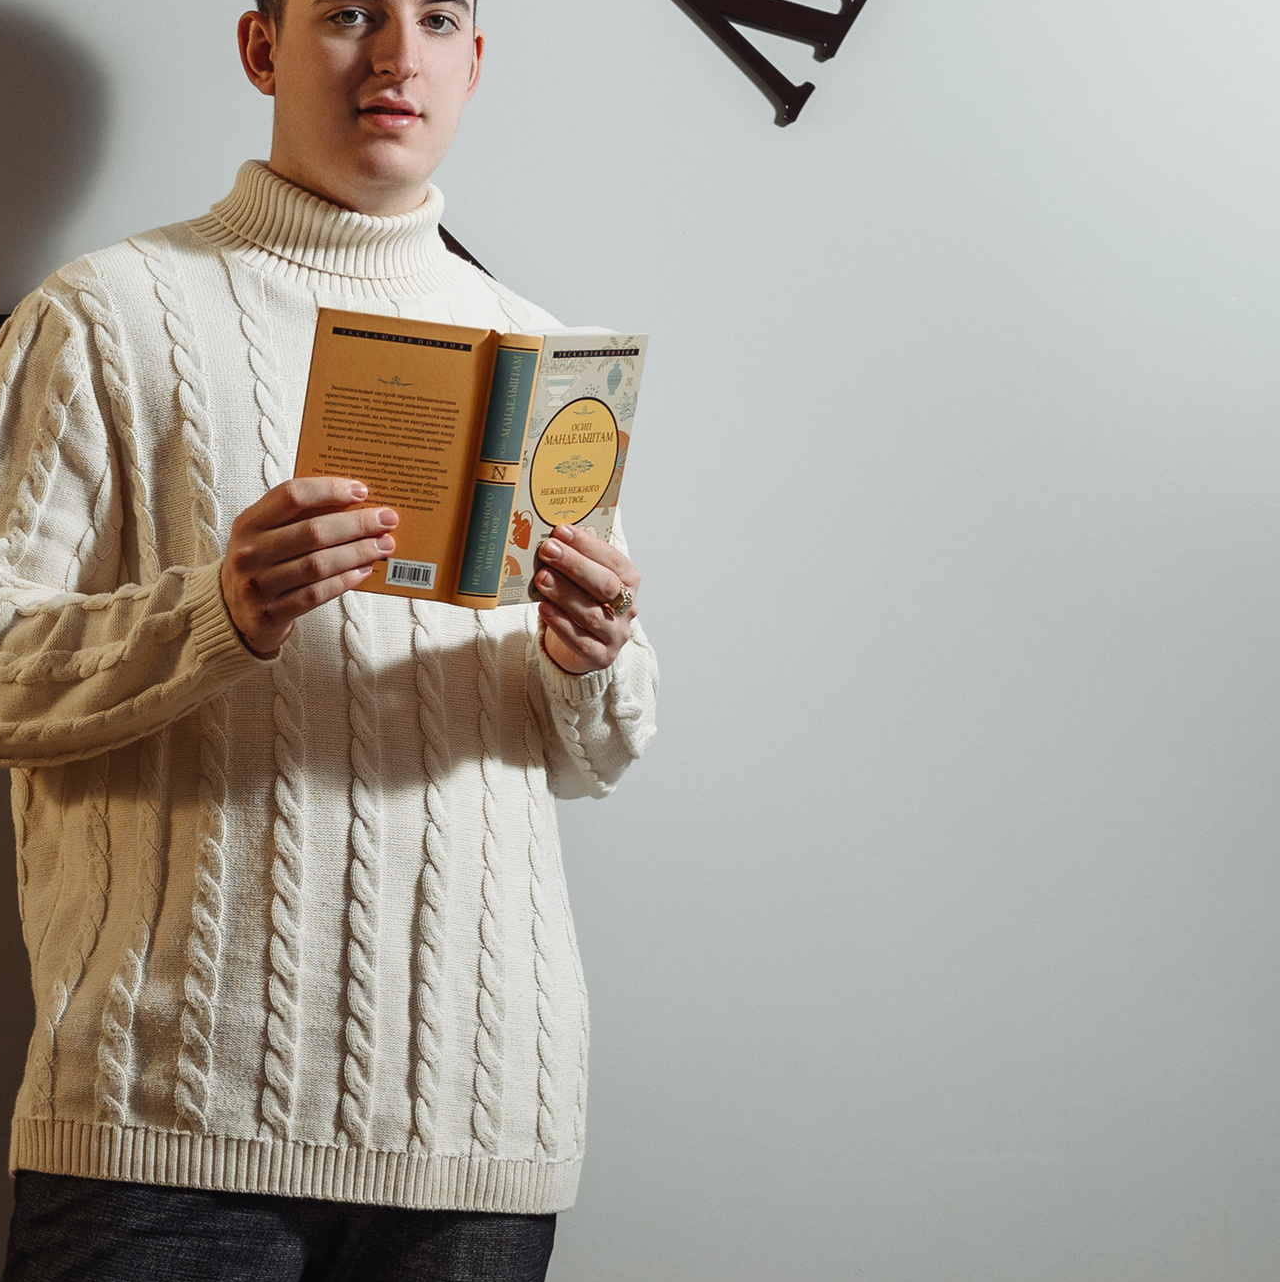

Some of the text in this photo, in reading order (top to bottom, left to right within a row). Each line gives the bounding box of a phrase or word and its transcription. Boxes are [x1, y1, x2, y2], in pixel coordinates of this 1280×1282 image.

[341, 329, 464, 350] ЭКСКЛЮЗИВ ПОЭЗИЯ
[500, 354, 522, 437] МАНДЕЛЬШТАМ
[571, 423, 592, 432] ОСИП
[544, 431, 614, 446] МАНДЕЛЬШТАМ
[540, 484, 600, 496] НЕЖНЕЕ НЕЖНОГО
[548, 496, 567, 506] ЛИЦО
[471, 492, 494, 585] НЕЖНЕЕ НЕЖНОГО
[484, 542, 495, 570] ЛИЦО
